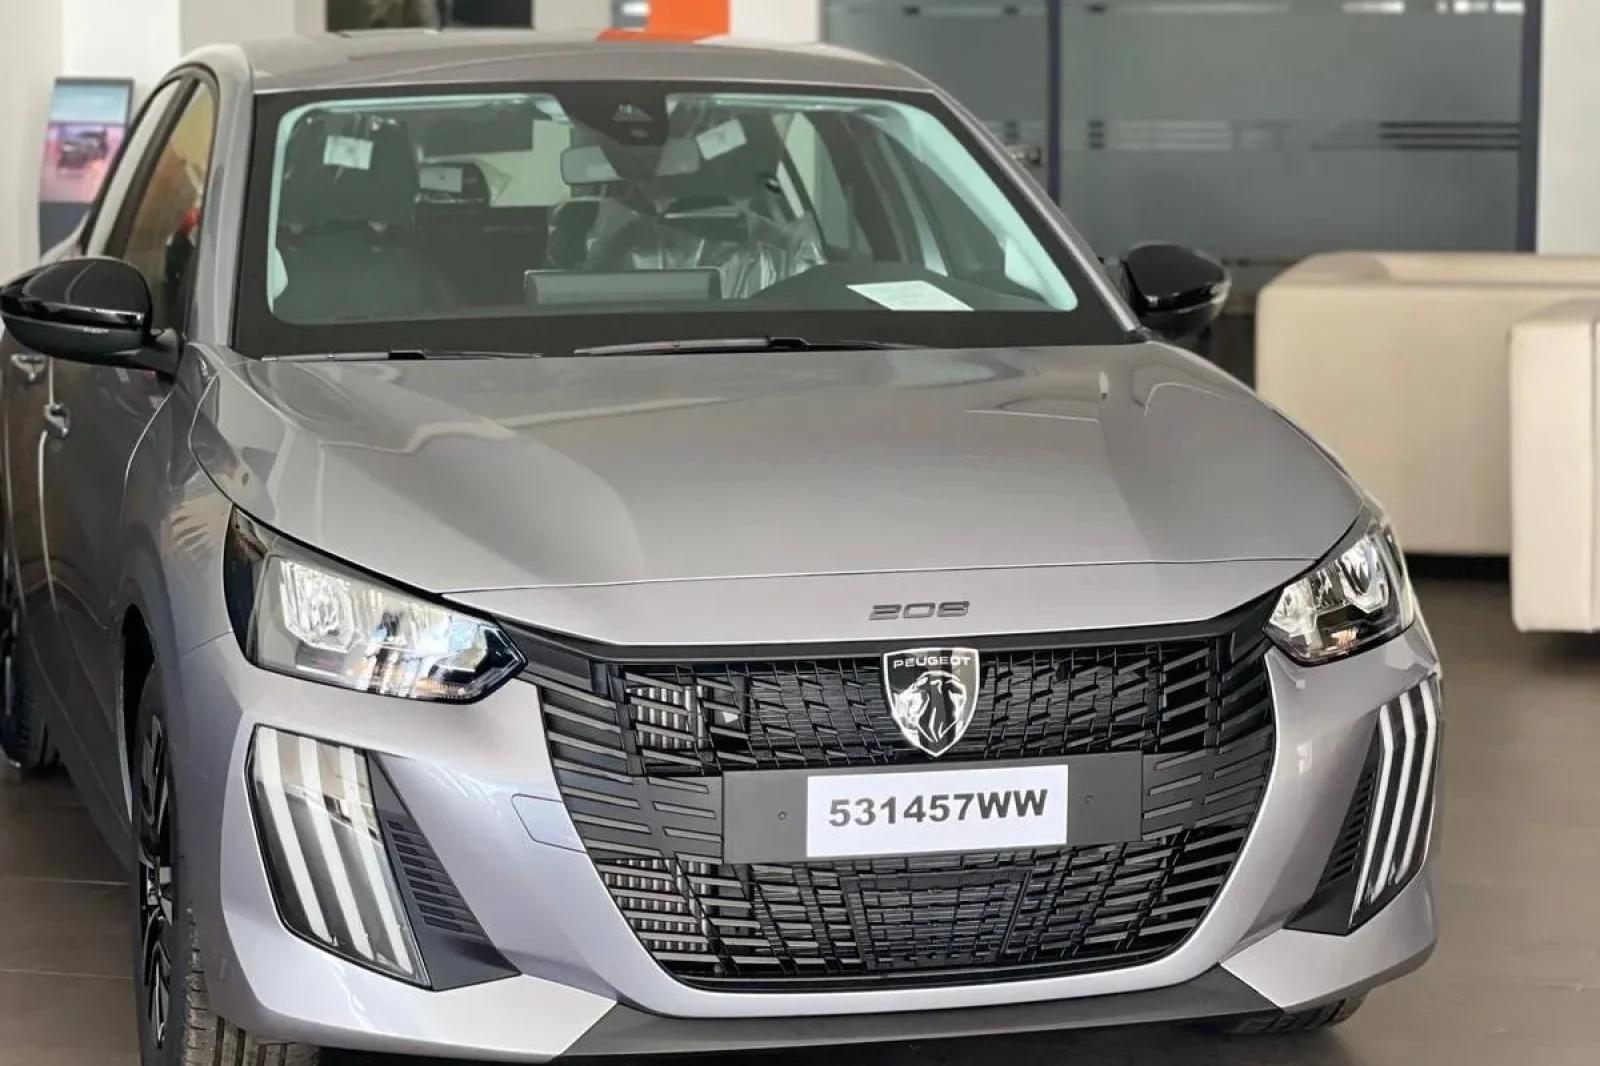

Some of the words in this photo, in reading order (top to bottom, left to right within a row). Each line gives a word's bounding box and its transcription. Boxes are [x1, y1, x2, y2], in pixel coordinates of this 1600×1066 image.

[868, 601, 970, 621] 208
[893, 655, 972, 669] PEUGEOT
[829, 789, 1048, 827] 531457WW
